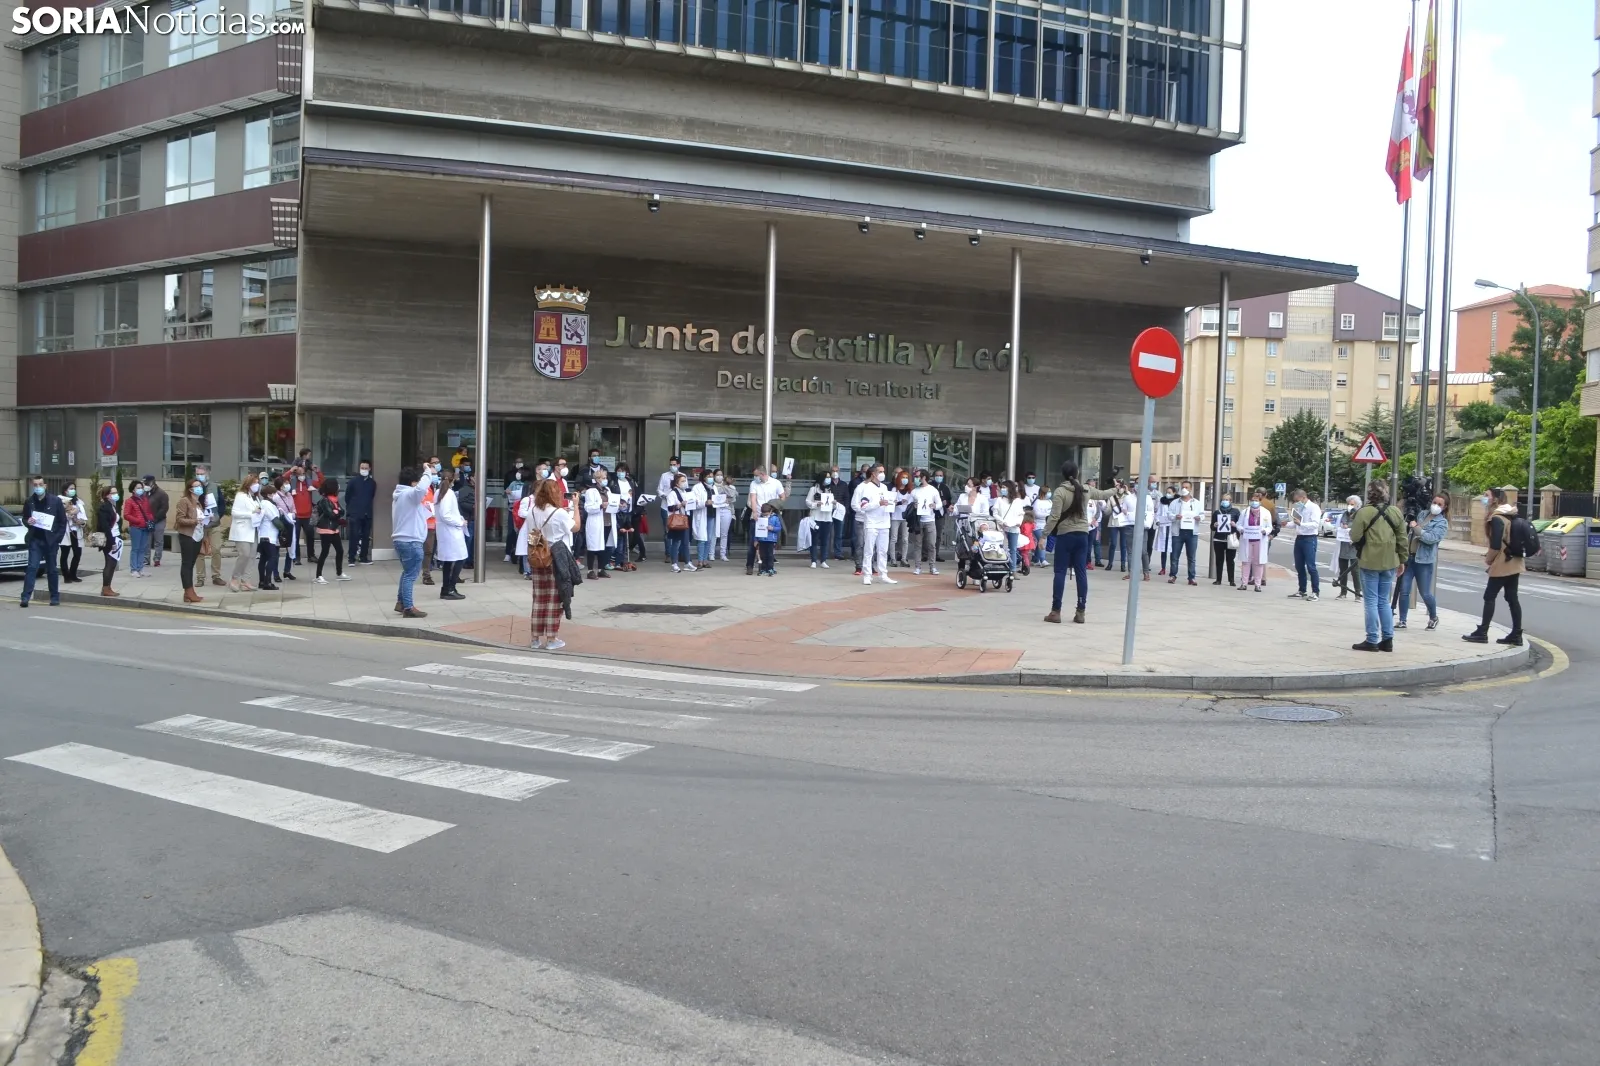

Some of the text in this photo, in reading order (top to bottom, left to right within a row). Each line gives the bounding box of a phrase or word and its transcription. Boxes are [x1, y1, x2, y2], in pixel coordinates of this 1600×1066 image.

[605, 316, 720, 353] Junta
[789, 328, 915, 366] Castilla
[922, 343, 945, 374] y
[953, 339, 1035, 373] León
[845, 378, 941, 400] Territorial
